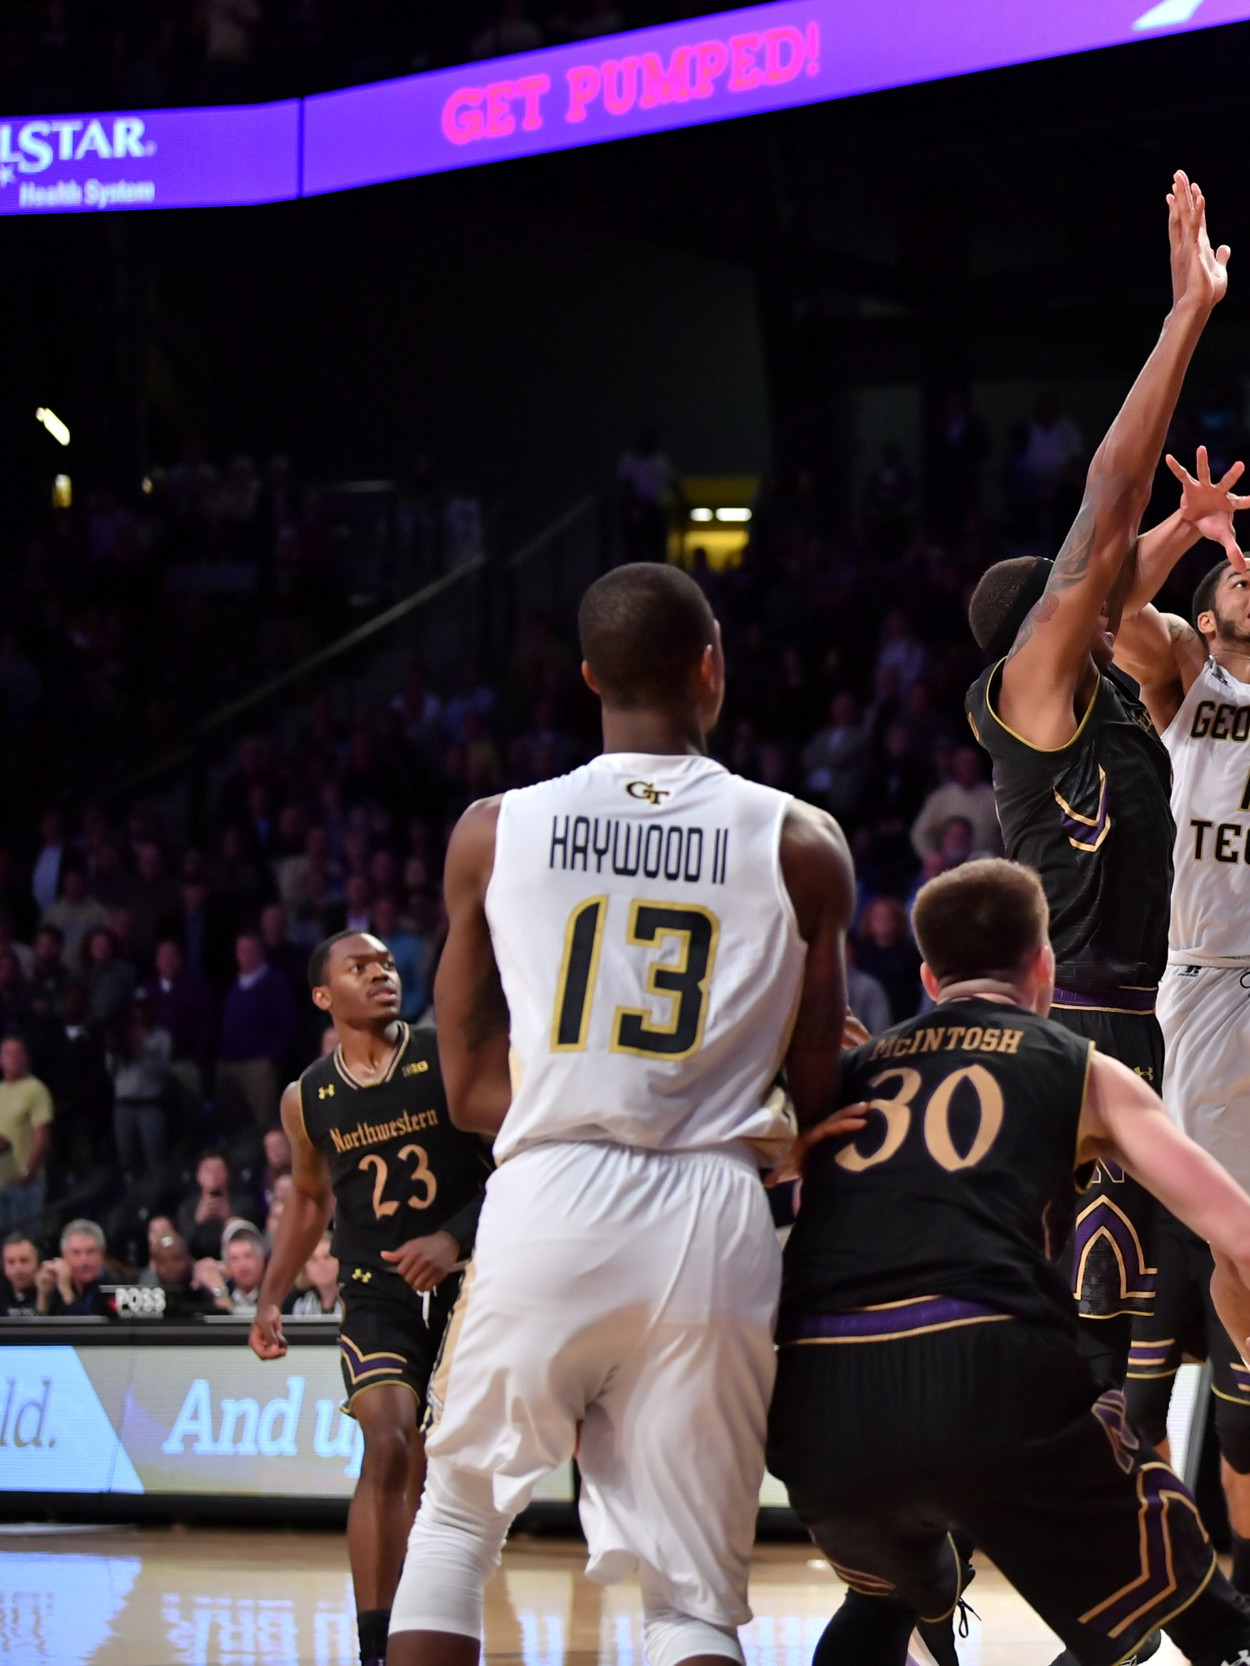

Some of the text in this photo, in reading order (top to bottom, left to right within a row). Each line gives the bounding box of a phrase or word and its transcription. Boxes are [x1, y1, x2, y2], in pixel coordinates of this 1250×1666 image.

[442, 21, 820, 145] GET PUMPED!
[19, 178, 155, 210] Health System
[549, 815, 704, 882] HAYWOOD
[550, 893, 721, 1061] 13
[330, 1108, 439, 1154] Northwestern
[834, 1063, 1004, 1172] 30
[358, 1144, 438, 1220] 23
[162, 1376, 305, 1456] And
